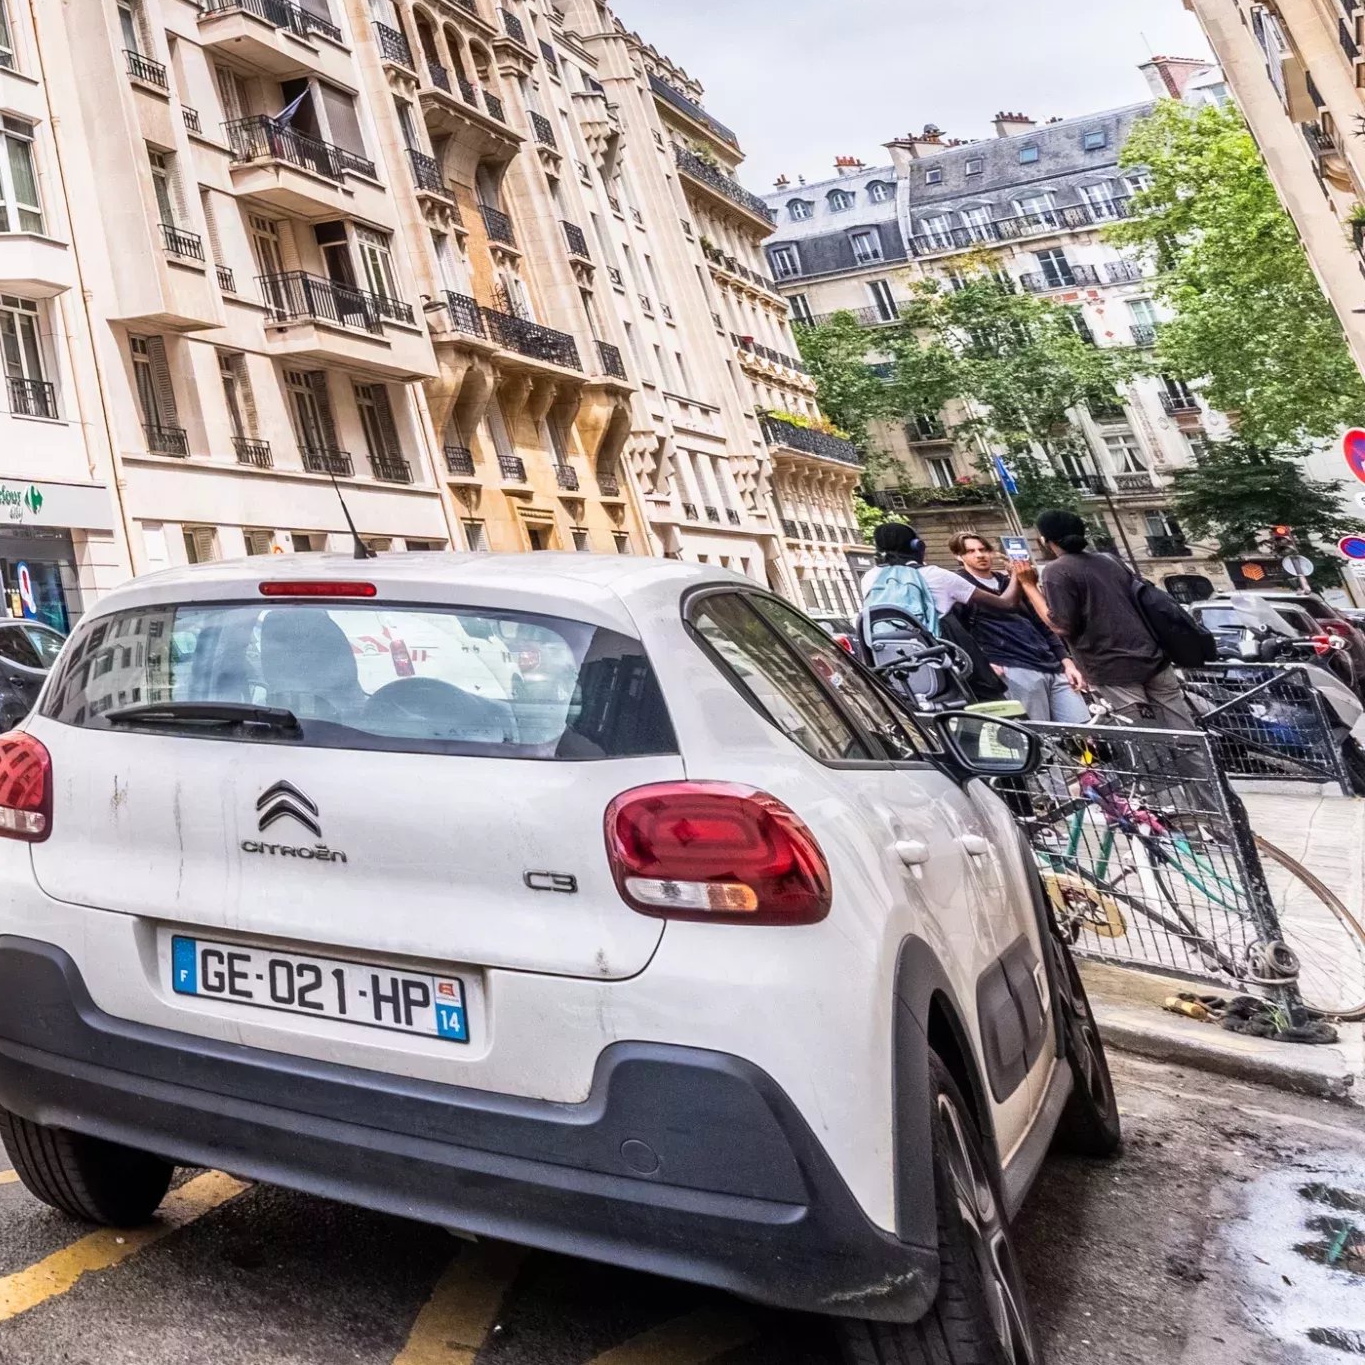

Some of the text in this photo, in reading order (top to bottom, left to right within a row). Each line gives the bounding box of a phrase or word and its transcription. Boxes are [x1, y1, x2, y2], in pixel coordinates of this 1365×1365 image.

[240, 839, 349, 864] CITROËN
[522, 868, 579, 894] C3
[179, 948, 461, 1033] F GE-021-HP 14
